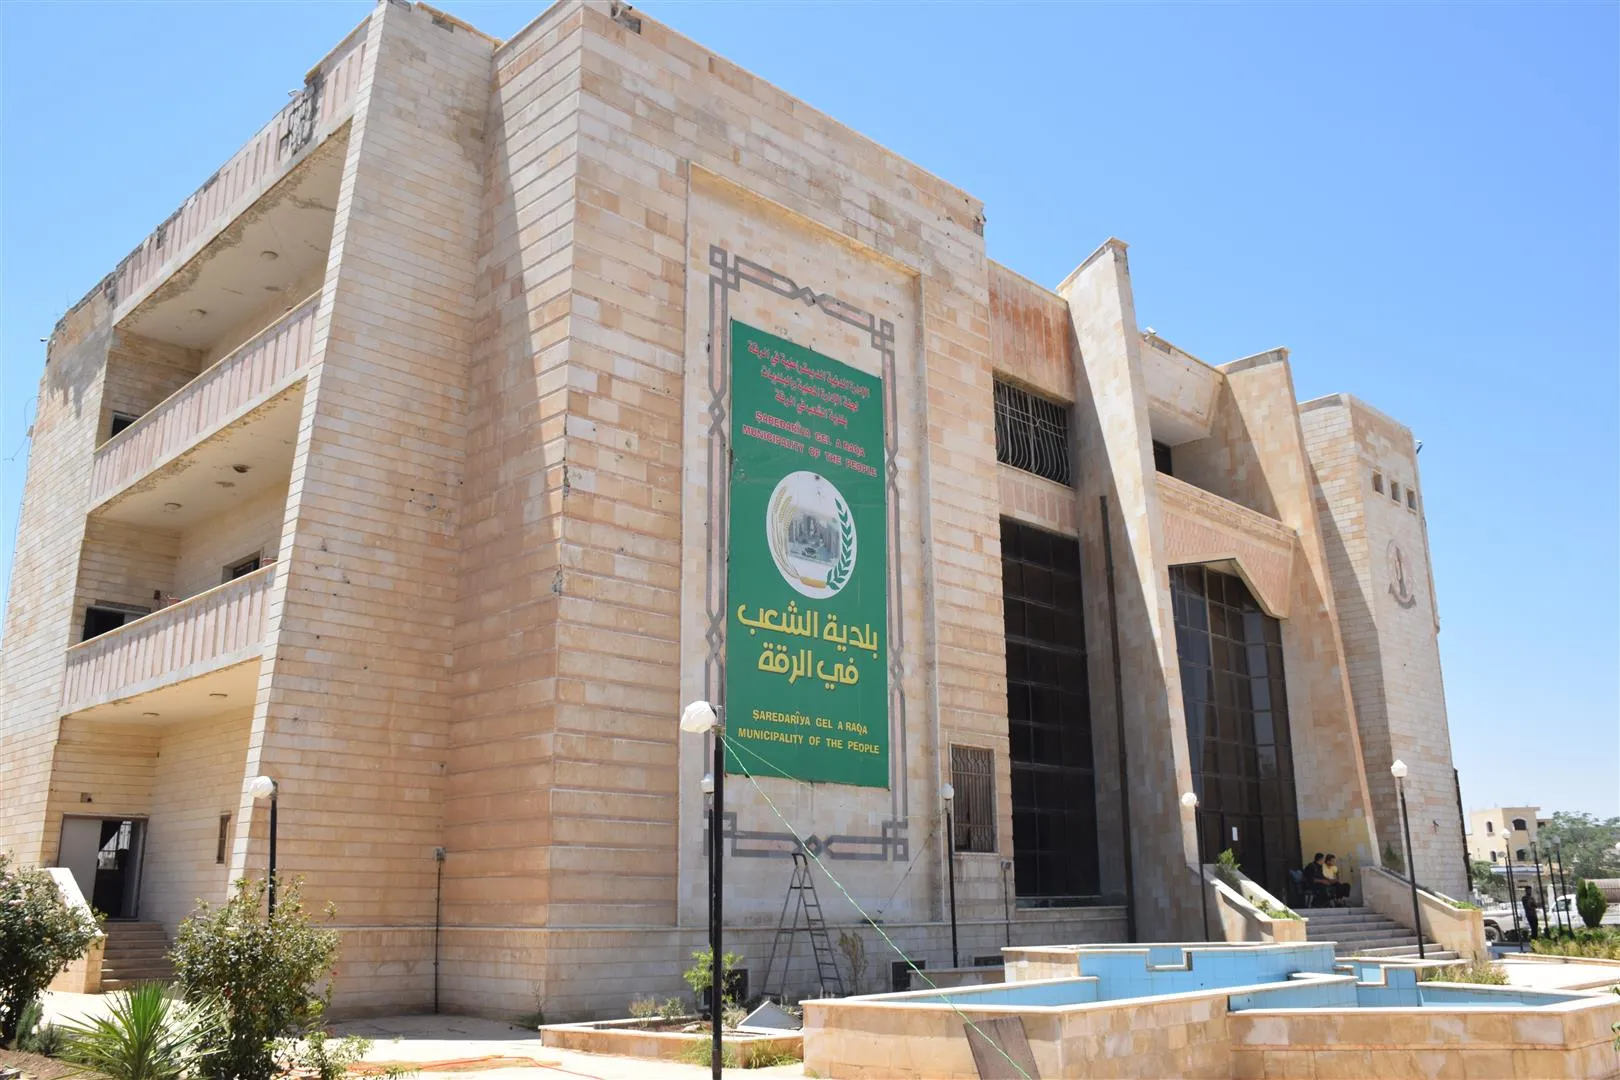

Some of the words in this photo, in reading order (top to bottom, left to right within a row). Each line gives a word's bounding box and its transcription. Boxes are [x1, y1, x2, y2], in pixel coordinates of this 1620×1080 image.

[742, 424, 804, 453] MUNICIPALITY
[808, 446, 820, 458] OF
[824, 451, 842, 465] THE
[847, 458, 877, 477] PEOPLE
[815, 432, 832, 446] GEL
[836, 439, 842, 449] A
[737, 600, 819, 638] الشعب
[823, 613, 878, 660] بلدية
[758, 641, 812, 684] الرقة
[817, 657, 859, 690] في
[752, 709, 811, 726] ŞAREDARÎYA
[815, 716, 833, 729] GEL
[837, 720, 844, 731] A
[845, 721, 868, 736] RAQA
[738, 727, 804, 745] MUNICIPALITY
[809, 735, 821, 746] OF
[826, 738, 843, 749] THE
[848, 740, 880, 755] PEOPLE
